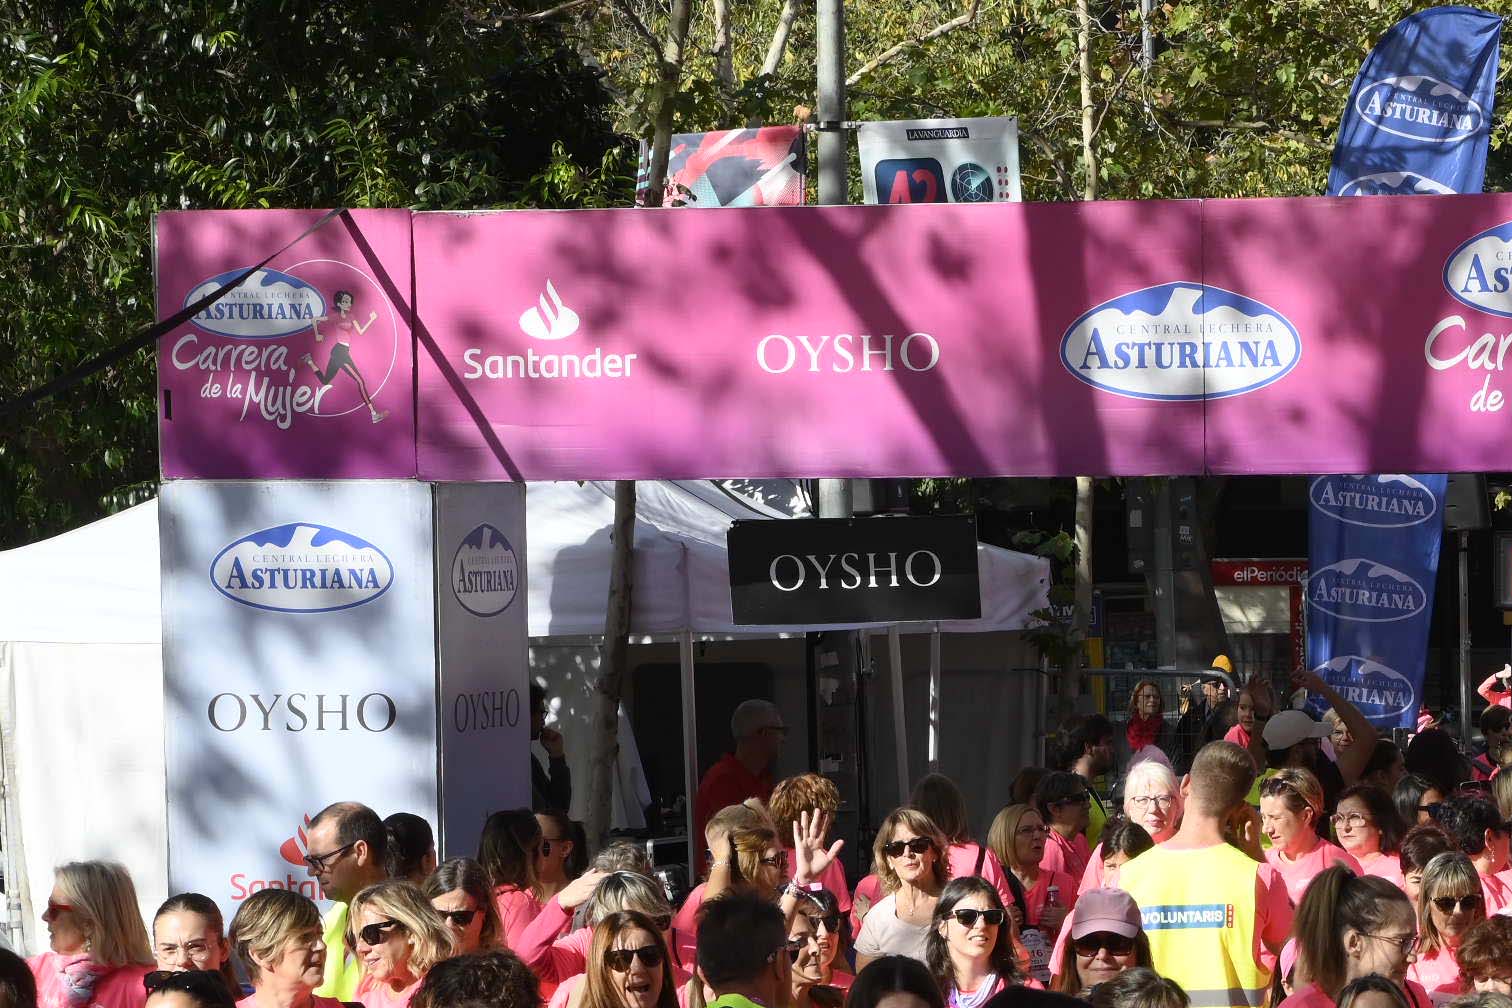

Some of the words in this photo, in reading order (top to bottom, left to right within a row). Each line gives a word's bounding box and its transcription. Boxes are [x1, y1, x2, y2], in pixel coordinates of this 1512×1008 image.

[1366, 91, 1473, 131] ASTURIANA
[1116, 323, 1190, 334] CENTRAL
[1199, 322, 1273, 334] LECHERA
[171, 334, 288, 371] Carrera
[463, 348, 637, 379] Santander
[756, 333, 940, 374] OYSHO
[1079, 326, 1281, 373] ASTURIANA
[200, 373, 221, 398] de
[227, 372, 242, 398] la
[240, 367, 333, 430] Mujer
[1469, 377, 1504, 413] de
[1318, 481, 1426, 517] ASTURIANA
[225, 556, 381, 589] ASTURIANA
[253, 554, 310, 563] CENTRAL
[457, 558, 515, 594] ASTURIANA
[769, 550, 942, 592] OYSHO
[1233, 566, 1302, 583] elPeriódi
[1313, 576, 1416, 610] ASTURIANA
[207, 692, 397, 733] OYSHO
[454, 688, 520, 733] OYSHO
[1140, 909, 1223, 925] VOLUNTARIS
